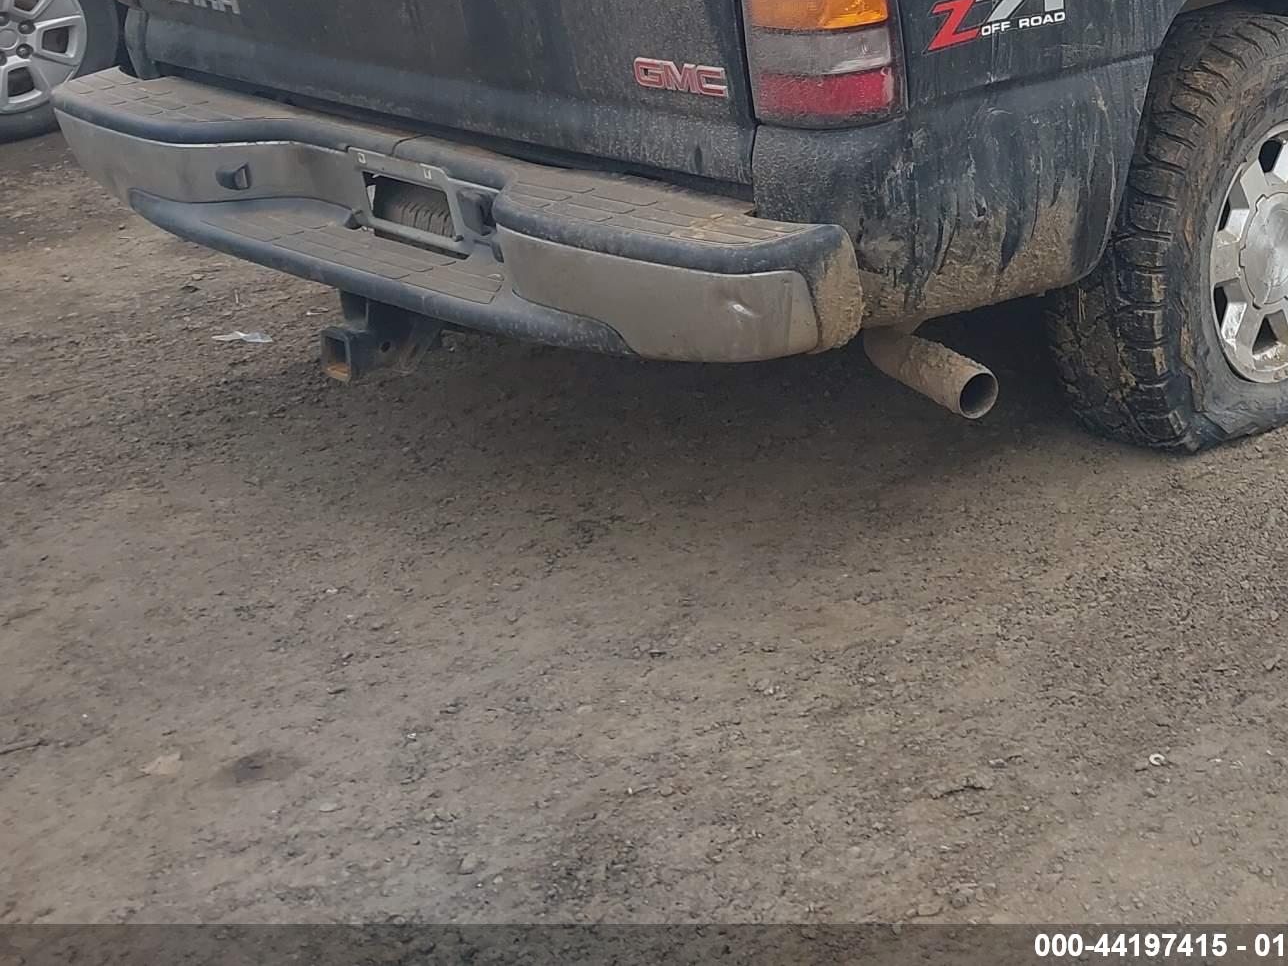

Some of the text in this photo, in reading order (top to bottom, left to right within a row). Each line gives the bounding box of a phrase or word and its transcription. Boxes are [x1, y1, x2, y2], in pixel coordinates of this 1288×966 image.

[981, 11, 1066, 36] OFF ROAD
[633, 56, 729, 99] GMC
